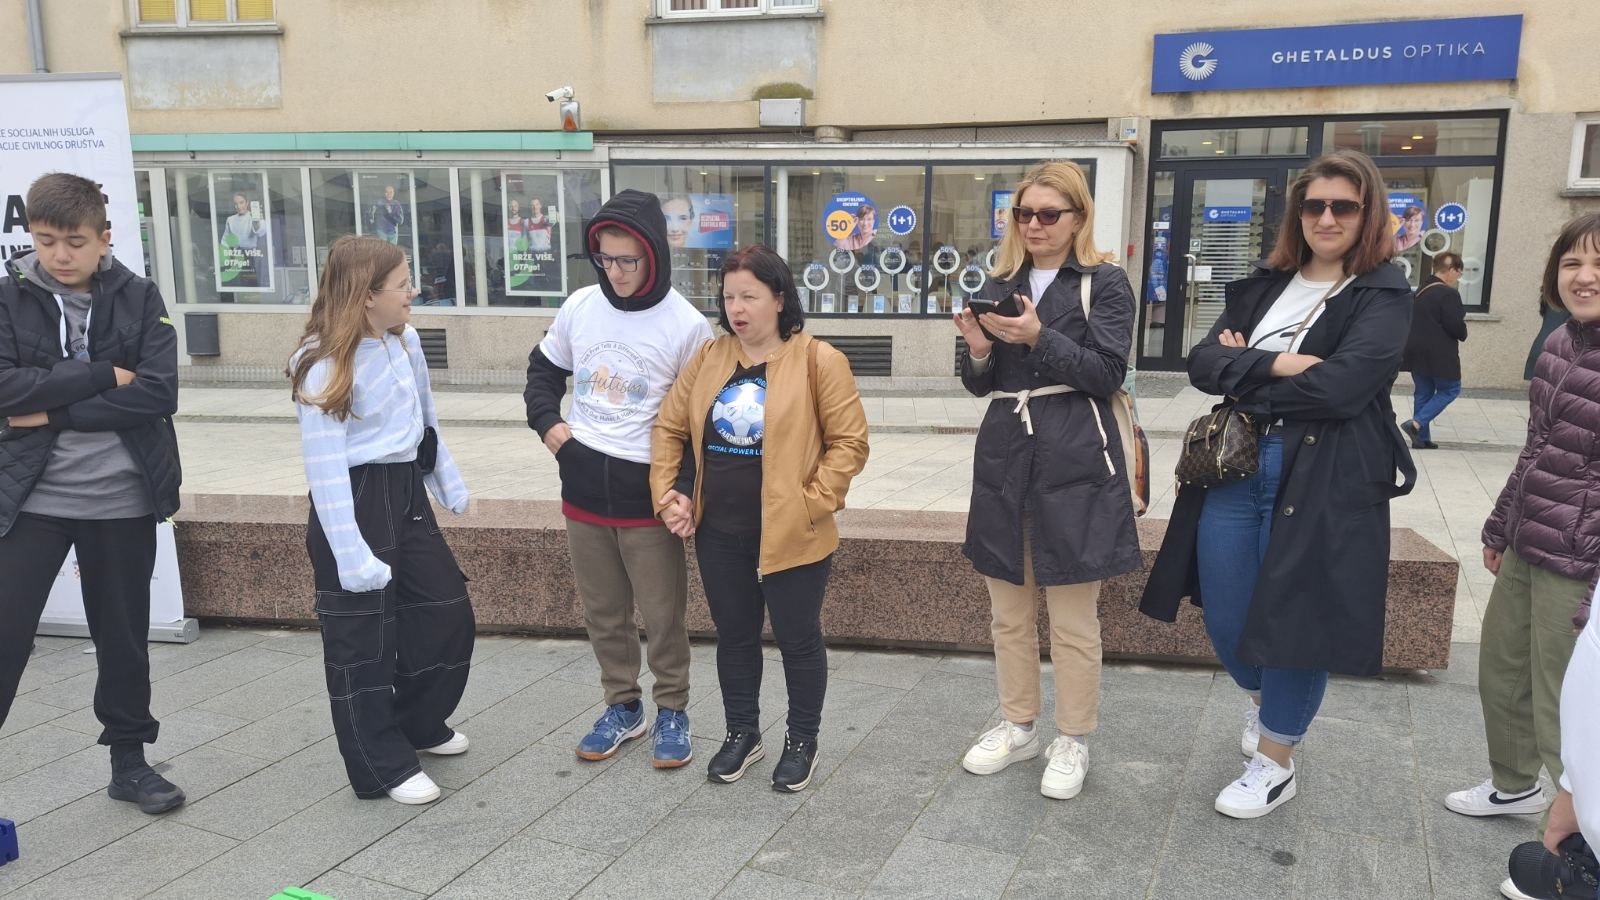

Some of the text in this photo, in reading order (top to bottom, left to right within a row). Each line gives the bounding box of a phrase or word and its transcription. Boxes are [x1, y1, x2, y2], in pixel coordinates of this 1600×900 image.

[1272, 42, 1486, 63] GHETALDUS OPTIKA
[7, 127, 58, 137] SOCIJALNIH
[60, 127, 95, 136] USLUGA
[22, 140, 63, 150] CIVILNOG
[65, 138, 104, 149] DRUŠTVA
[891, 215, 912, 226] 1+1
[1440, 212, 1464, 224] 1+1
[535, 252, 554, 262] VIŠE,
[513, 263, 540, 272] OTPgo!
[577, 371, 642, 395] Autism
[728, 447, 754, 456] POWER
